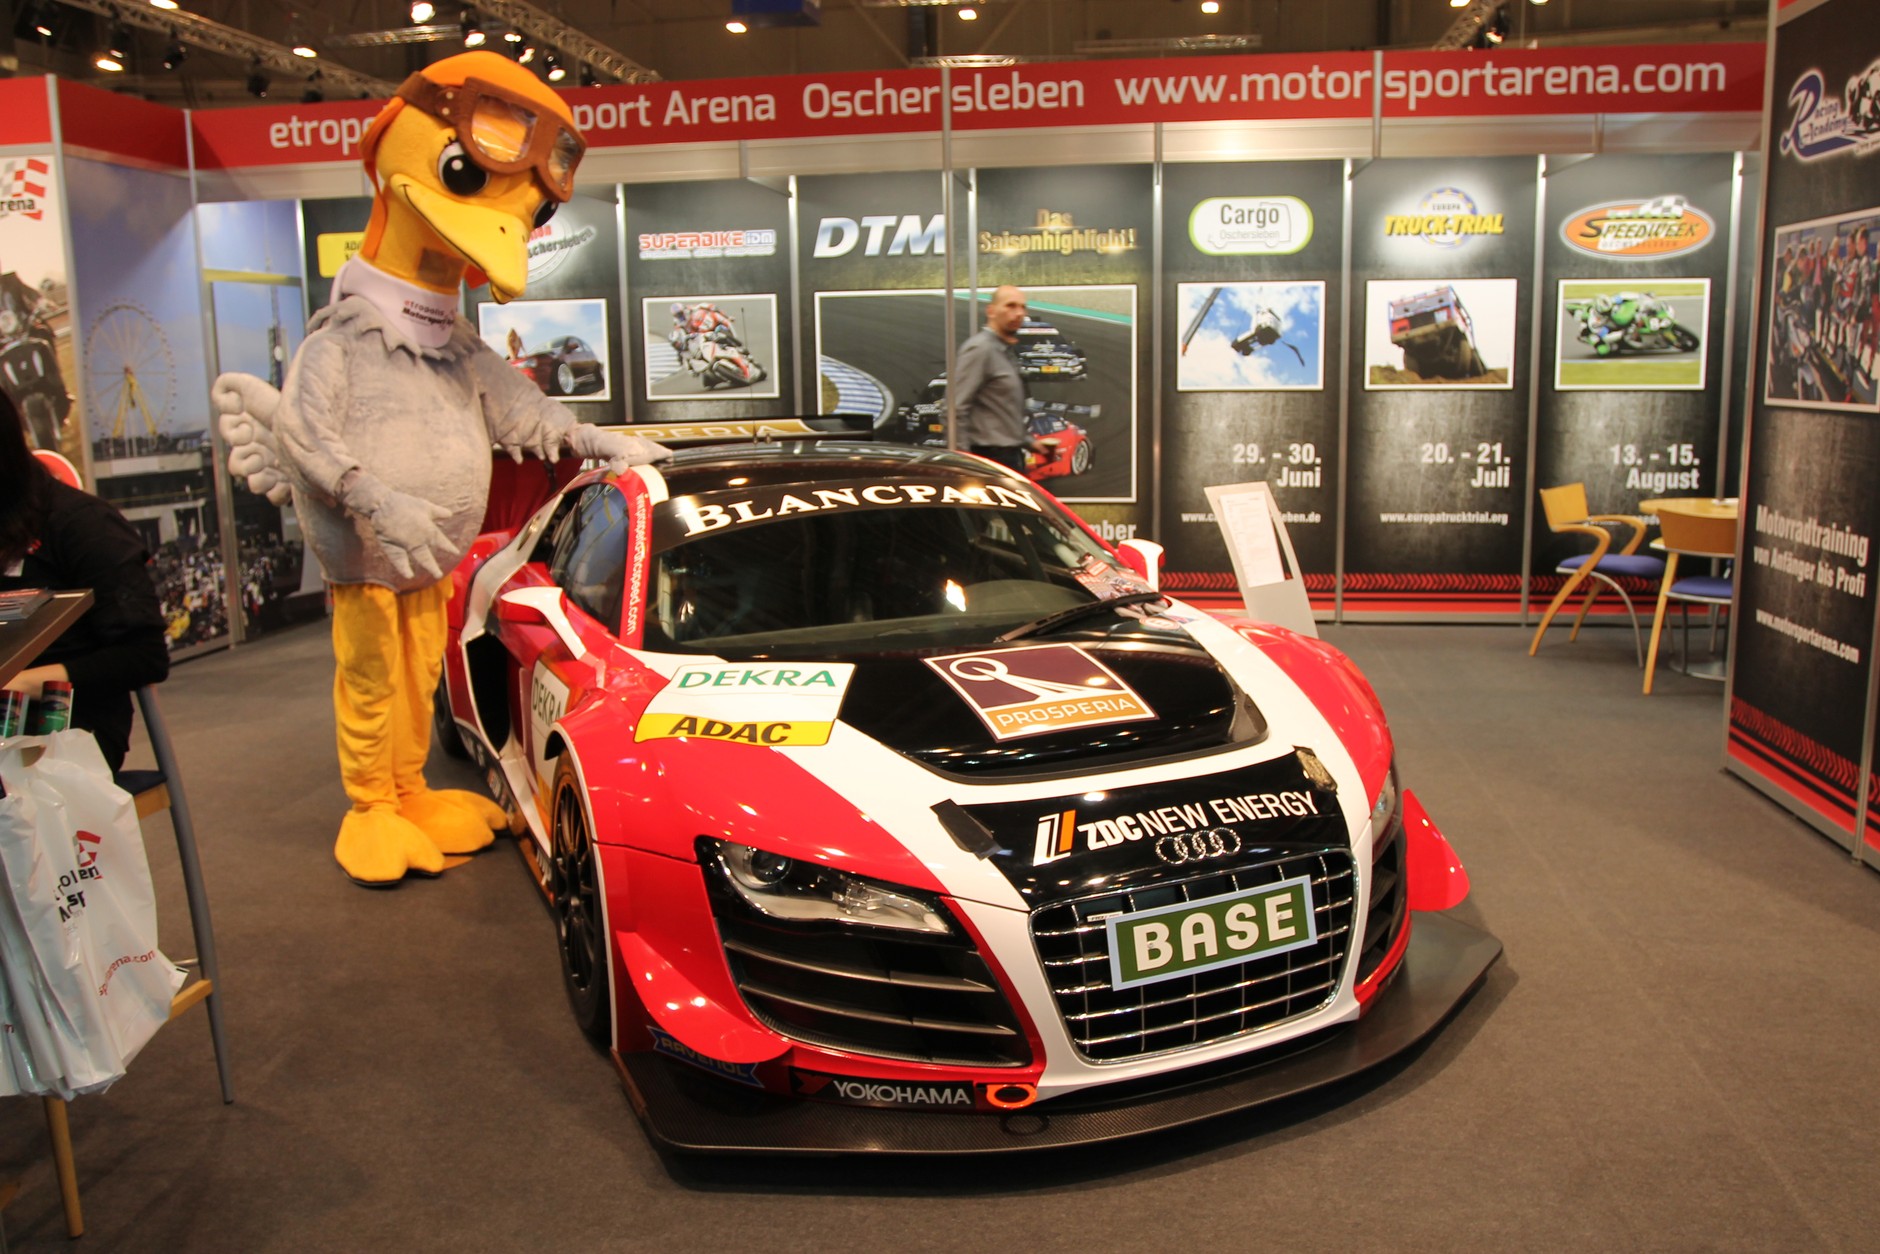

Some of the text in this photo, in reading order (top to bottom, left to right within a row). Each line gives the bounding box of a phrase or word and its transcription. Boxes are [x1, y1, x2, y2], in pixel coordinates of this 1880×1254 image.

[663, 90, 776, 126] Arena
[802, 71, 1084, 119] Oschersleben
[1114, 61, 1726, 111] www.motorsportarena.com
[1037, 208, 1074, 230] Das
[1220, 203, 1280, 229] Cargo
[1384, 213, 1505, 237] TRUCK-TRIAL
[639, 231, 745, 251] SUPERBIKE
[813, 213, 945, 259] DTM
[980, 230, 1138, 256] Saisonhighlight!
[1232, 442, 1266, 465] 29.
[1288, 442, 1322, 465] 30.
[1421, 442, 1455, 464] 20.
[1476, 442, 1511, 464] 21.
[1610, 444, 1644, 466] 13.
[1666, 444, 1700, 466] 15.
[1276, 466, 1322, 488] Juni
[1471, 465, 1511, 488] Juli
[1625, 467, 1701, 494] August
[675, 484, 1043, 537] BLANCPAIN
[1380, 511, 1509, 526] www.europatrucktrial.org
[1755, 504, 1870, 568] Motorradtraining
[1753, 546, 1867, 598] von Anfänger bis Profi
[1755, 609, 1860, 665] www.motorsportarena.com
[677, 669, 837, 688] DEKRA
[996, 698, 1137, 728] PROSPERIA
[668, 716, 793, 744] ADAC
[1208, 790, 1319, 825] ENERGY
[1132, 892, 1297, 972] BASE
[833, 1079, 972, 1105] YOKOHAMA
